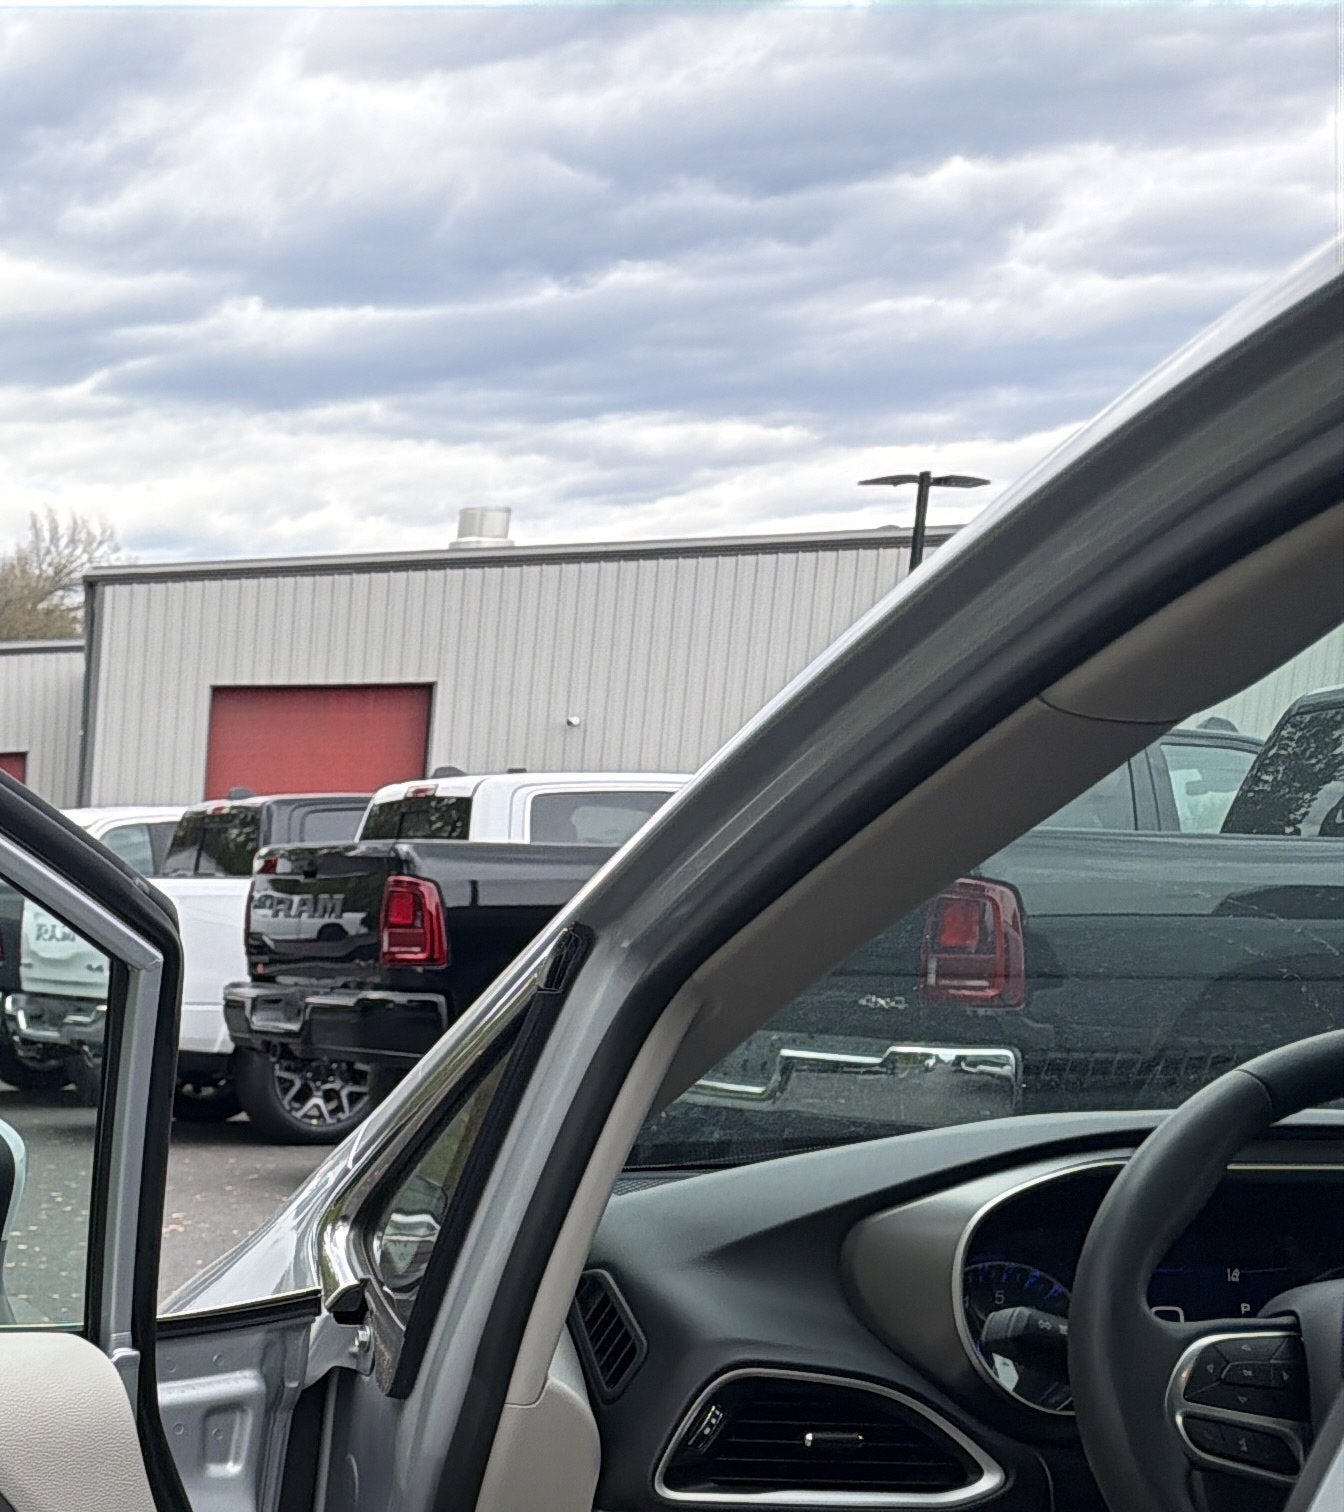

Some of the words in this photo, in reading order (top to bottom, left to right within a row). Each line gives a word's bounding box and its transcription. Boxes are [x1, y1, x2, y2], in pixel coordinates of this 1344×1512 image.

[272, 893, 345, 919] RAM
[994, 1290, 1005, 1305] 5
[1240, 1302, 1251, 1315] P
